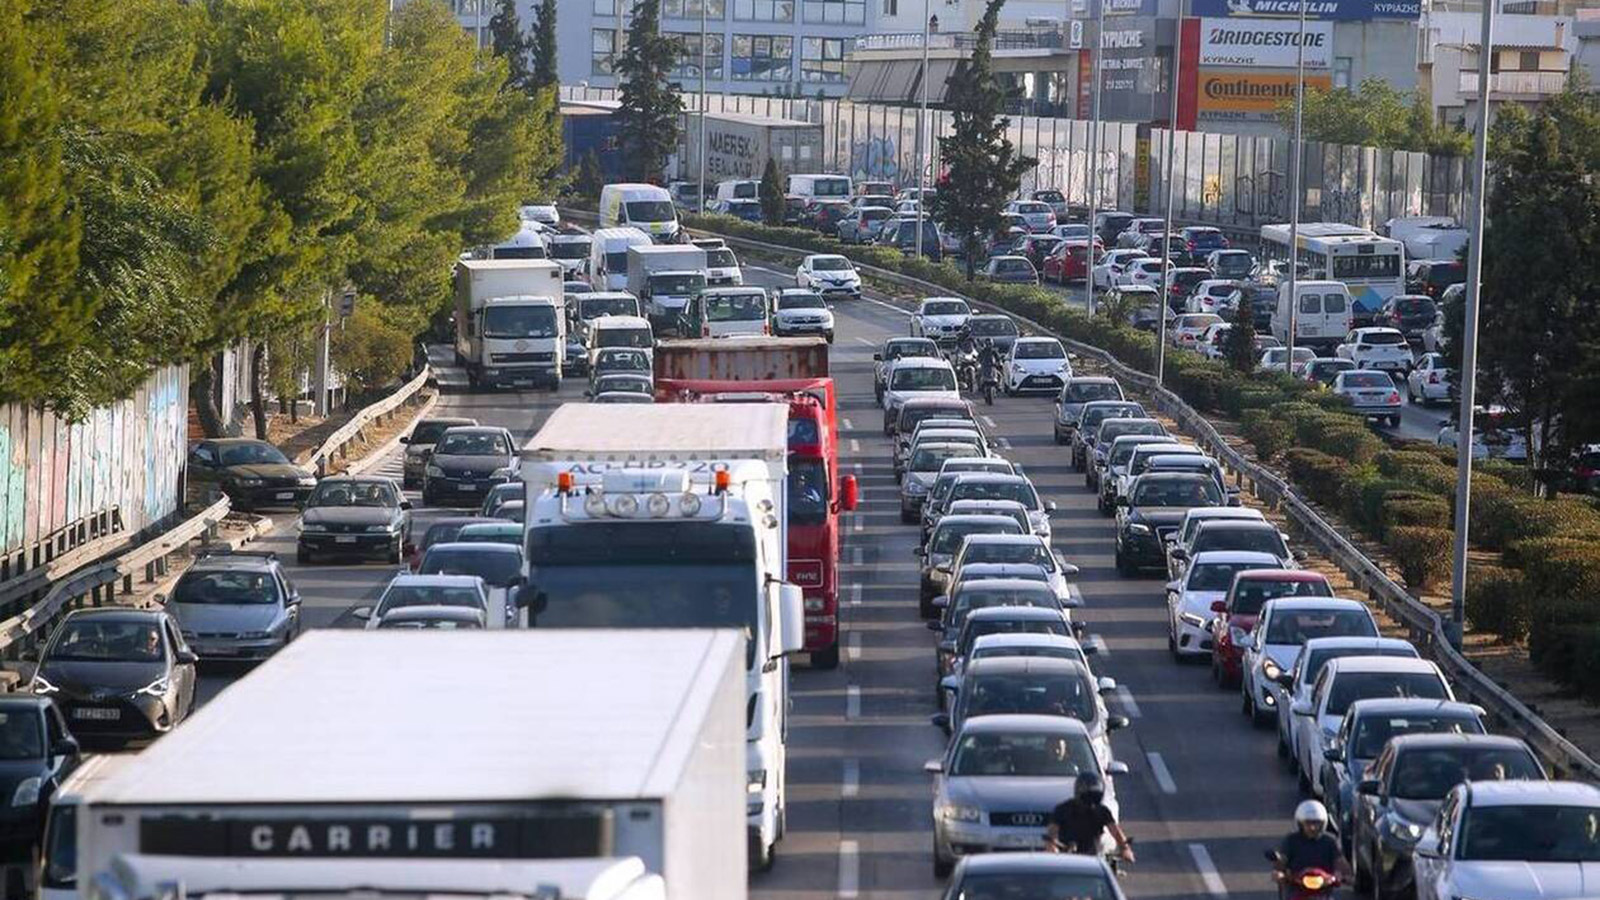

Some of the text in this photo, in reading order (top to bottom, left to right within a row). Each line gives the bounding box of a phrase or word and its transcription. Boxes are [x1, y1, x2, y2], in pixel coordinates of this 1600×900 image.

[1373, 3, 1419, 13] ΚΥΡΙΑΖΗΣ
[1208, 28, 1325, 47] BRIDGESTONE
[251, 823, 494, 851] CARRIER
